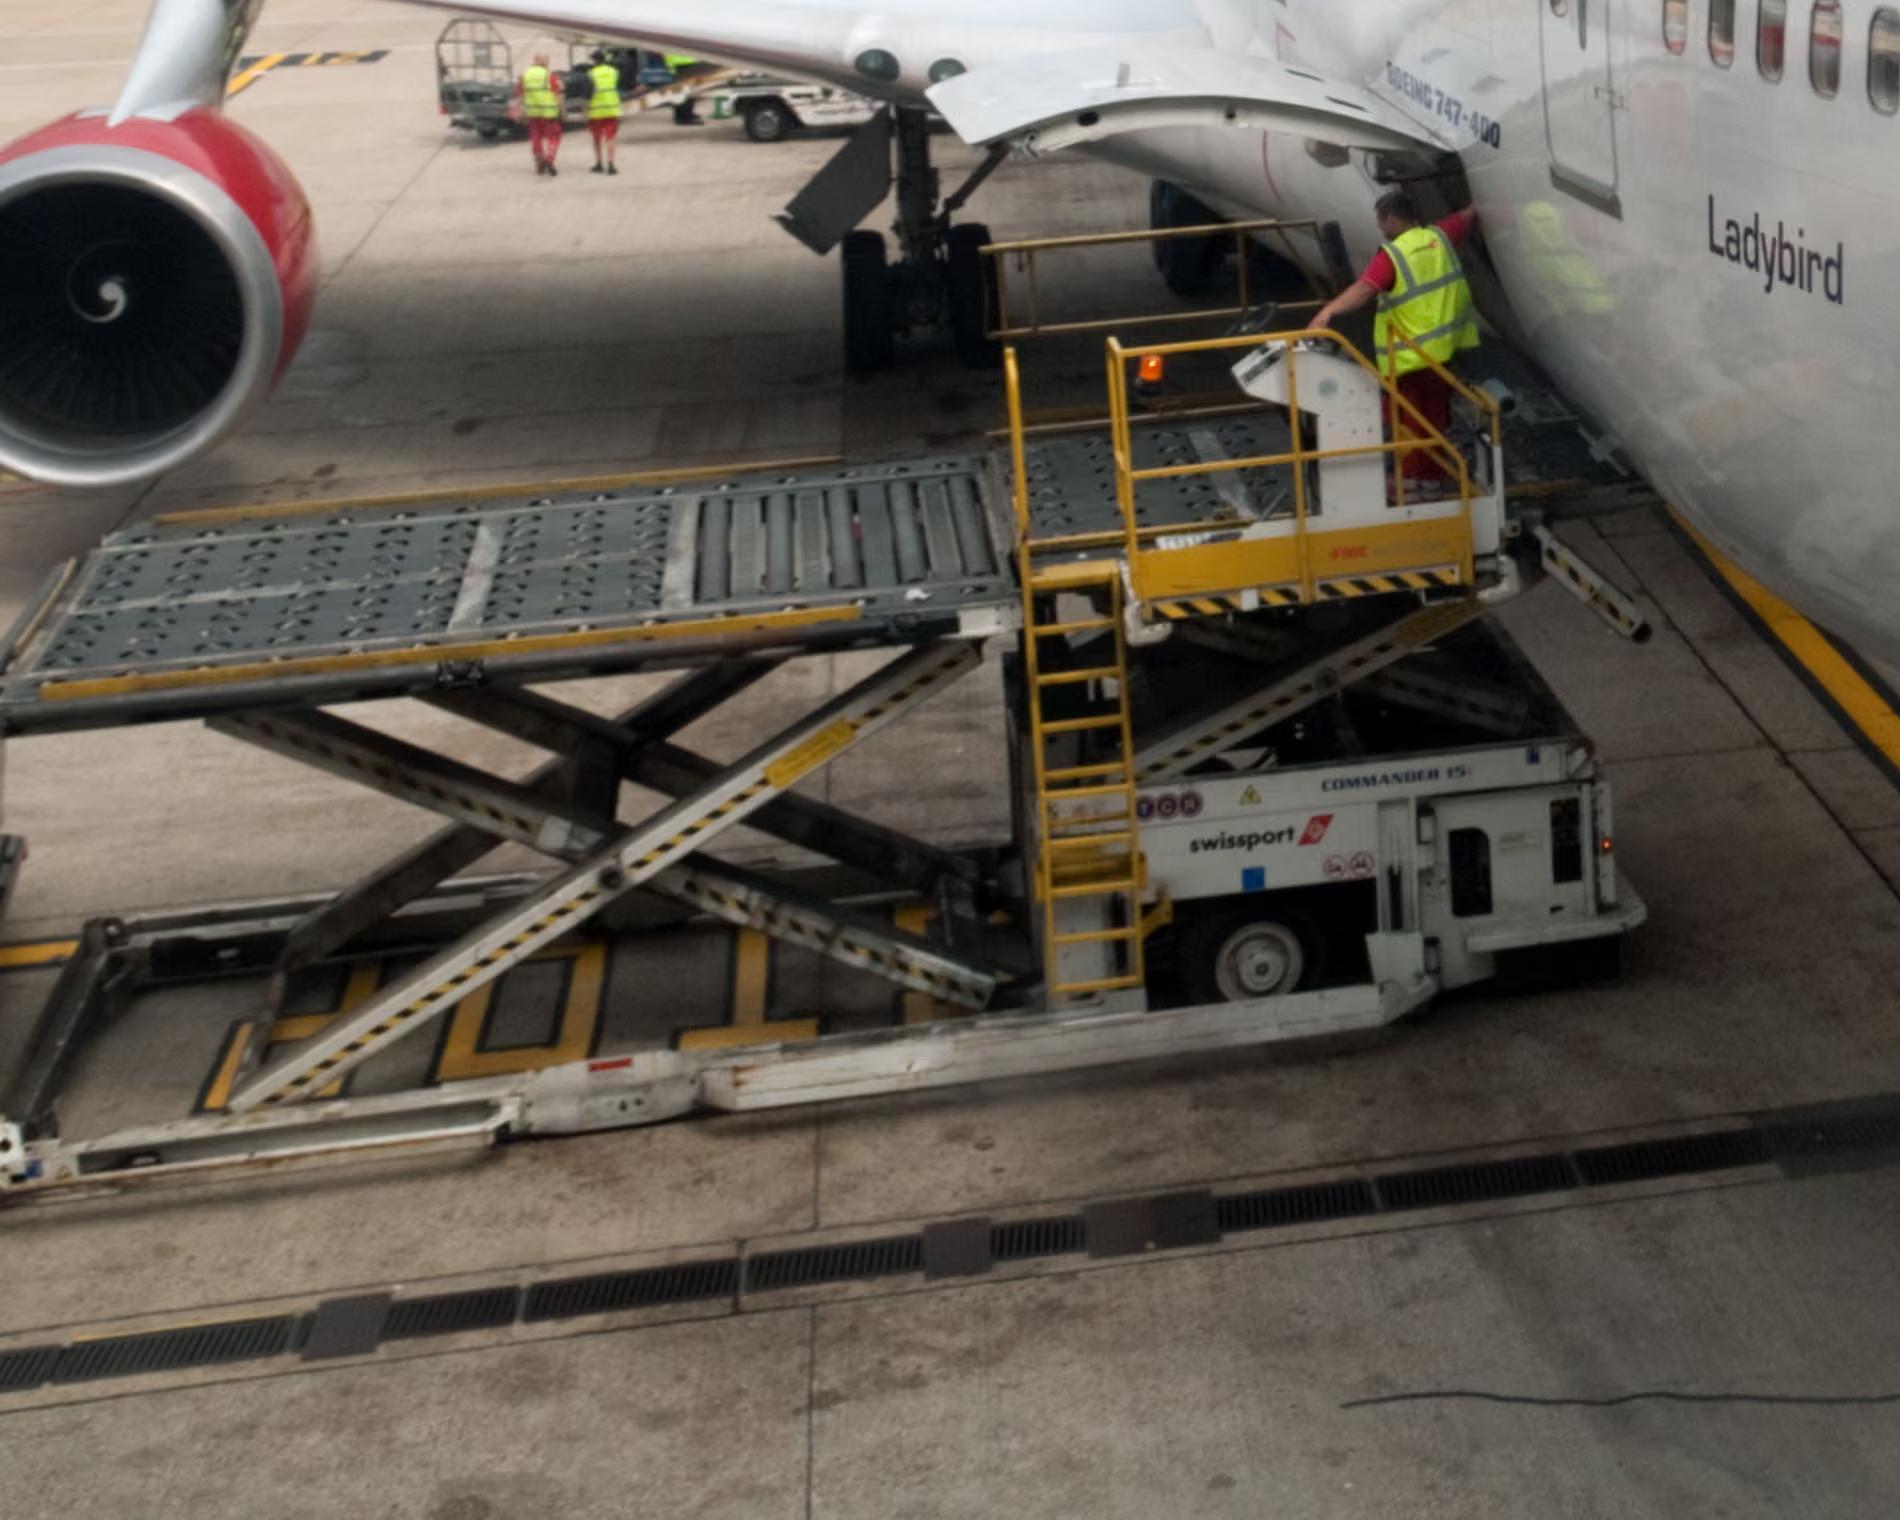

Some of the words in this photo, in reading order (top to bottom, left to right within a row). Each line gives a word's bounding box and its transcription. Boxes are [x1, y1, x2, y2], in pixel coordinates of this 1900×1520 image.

[1435, 87, 1500, 149] 747-400
[1708, 193, 1843, 305] Ladybird
[1321, 767, 1440, 792] COMMANDER
[1190, 826, 1295, 852] swissport
